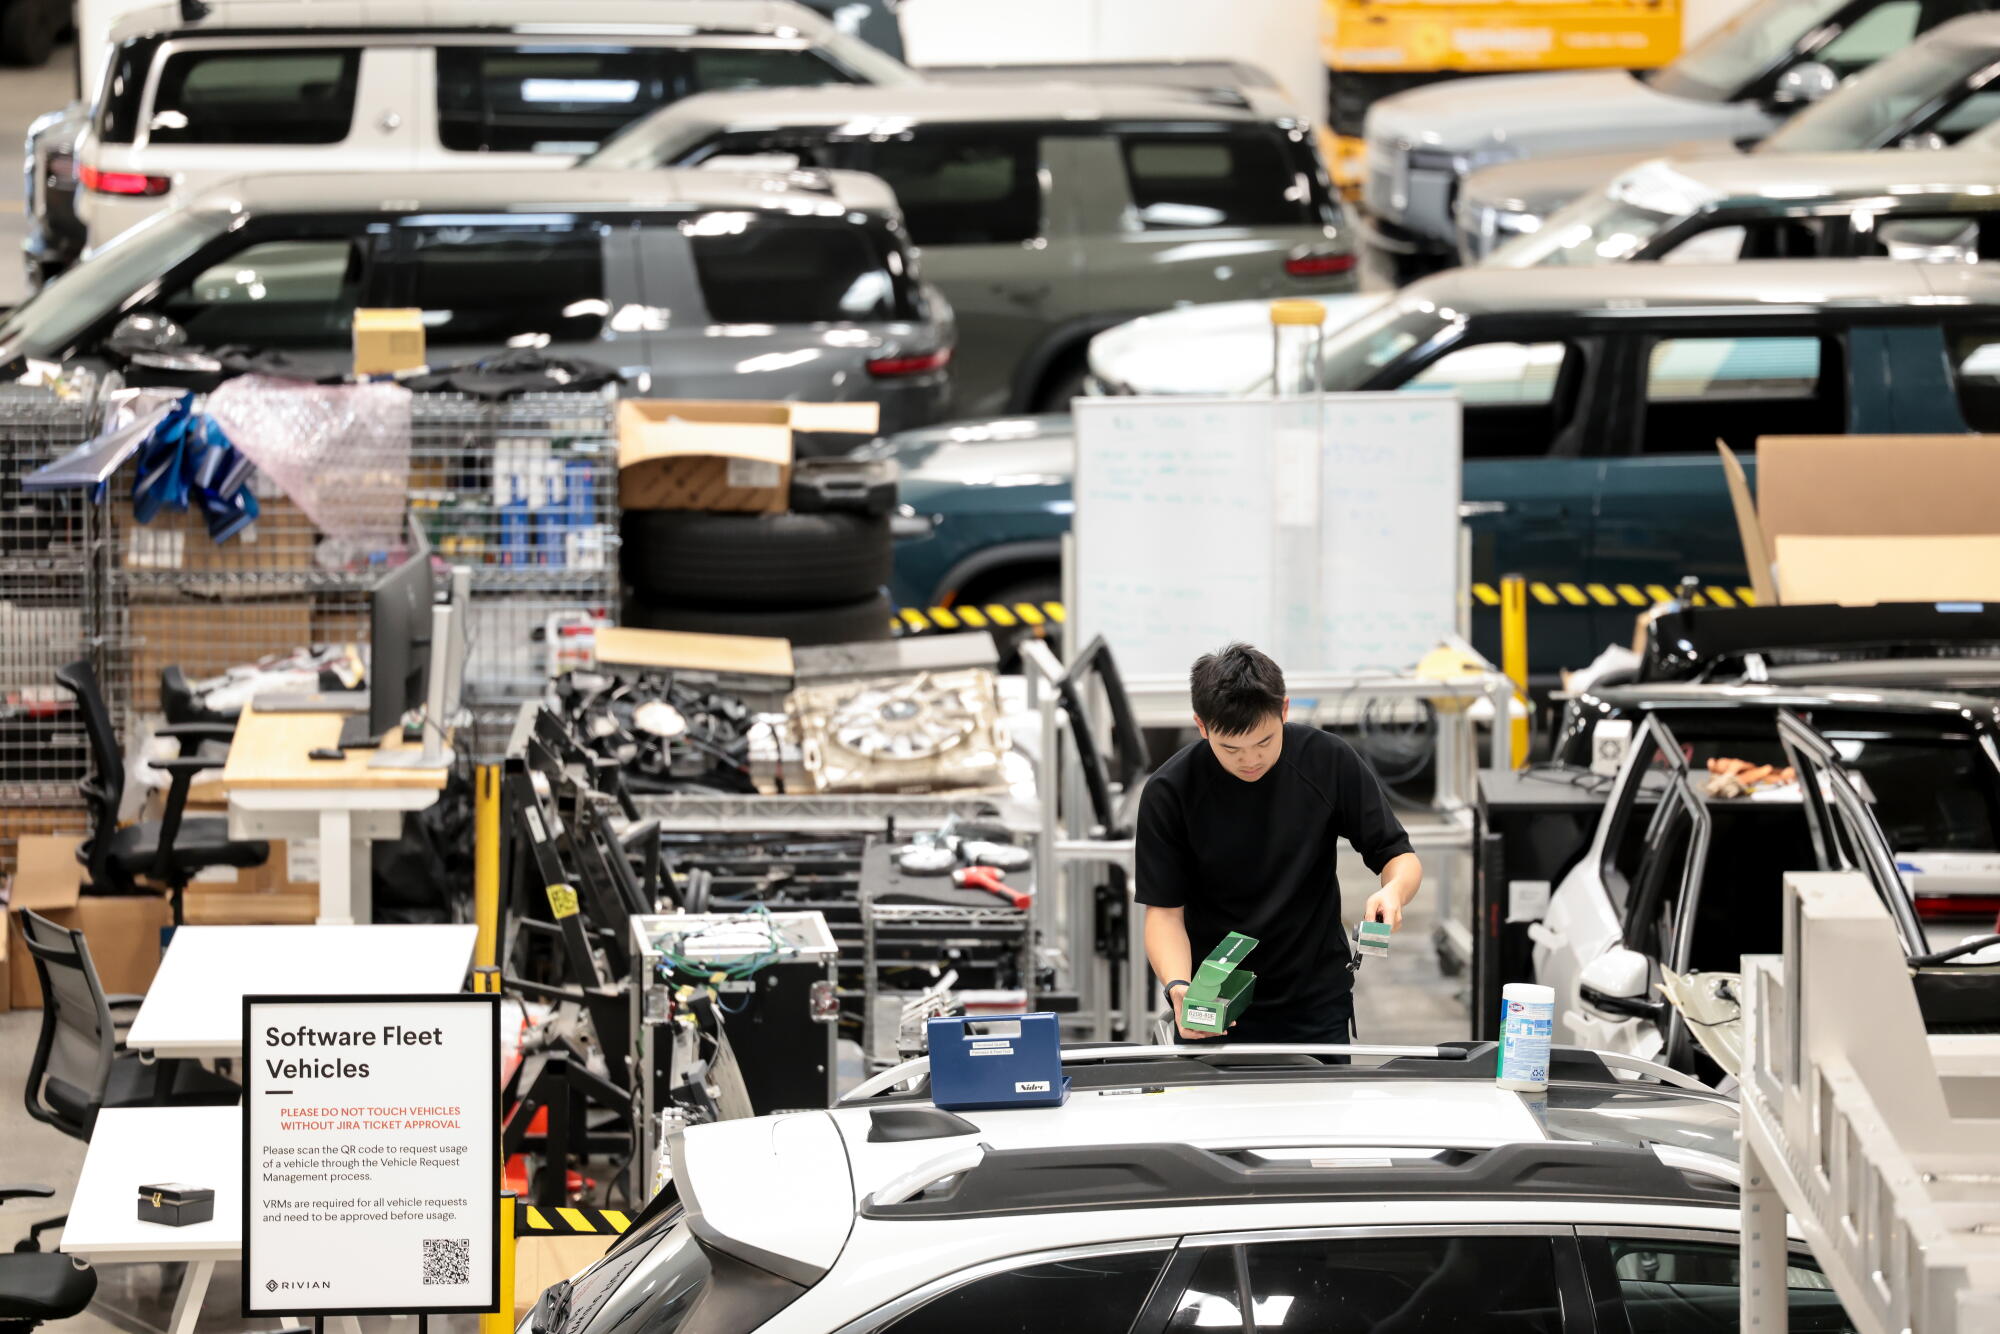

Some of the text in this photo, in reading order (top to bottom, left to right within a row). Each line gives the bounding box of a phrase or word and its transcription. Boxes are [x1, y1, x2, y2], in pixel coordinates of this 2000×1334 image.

[266, 1025, 443, 1047] Software Fleet
[265, 1057, 370, 1079] Vehicles
[281, 1106, 461, 1117] PLEASE DO NOT TOUCH VEHICLES
[280, 1120, 461, 1131] WITHOUT JIRA TICKET APPROVAL
[263, 1144, 468, 1156] Please scan the QR code to request usage
[262, 1159, 274, 1169] of
[283, 1158, 320, 1168] vehicle
[321, 1158, 360, 1170] through
[362, 1158, 378, 1167] the
[380, 1157, 417, 1167] Vehicle
[419, 1157, 460, 1169] Request
[263, 1172, 372, 1184] Management process.
[262, 1199, 292, 1209] VRMs
[312, 1198, 355, 1210] required
[357, 1198, 372, 1208] for
[373, 1197, 385, 1207] all
[386, 1197, 423, 1207] vehicle
[424, 1198, 468, 1208] requests
[262, 1210, 456, 1223] and need to be approved before usage.
[281, 1281, 330, 1289] RIVIAN
